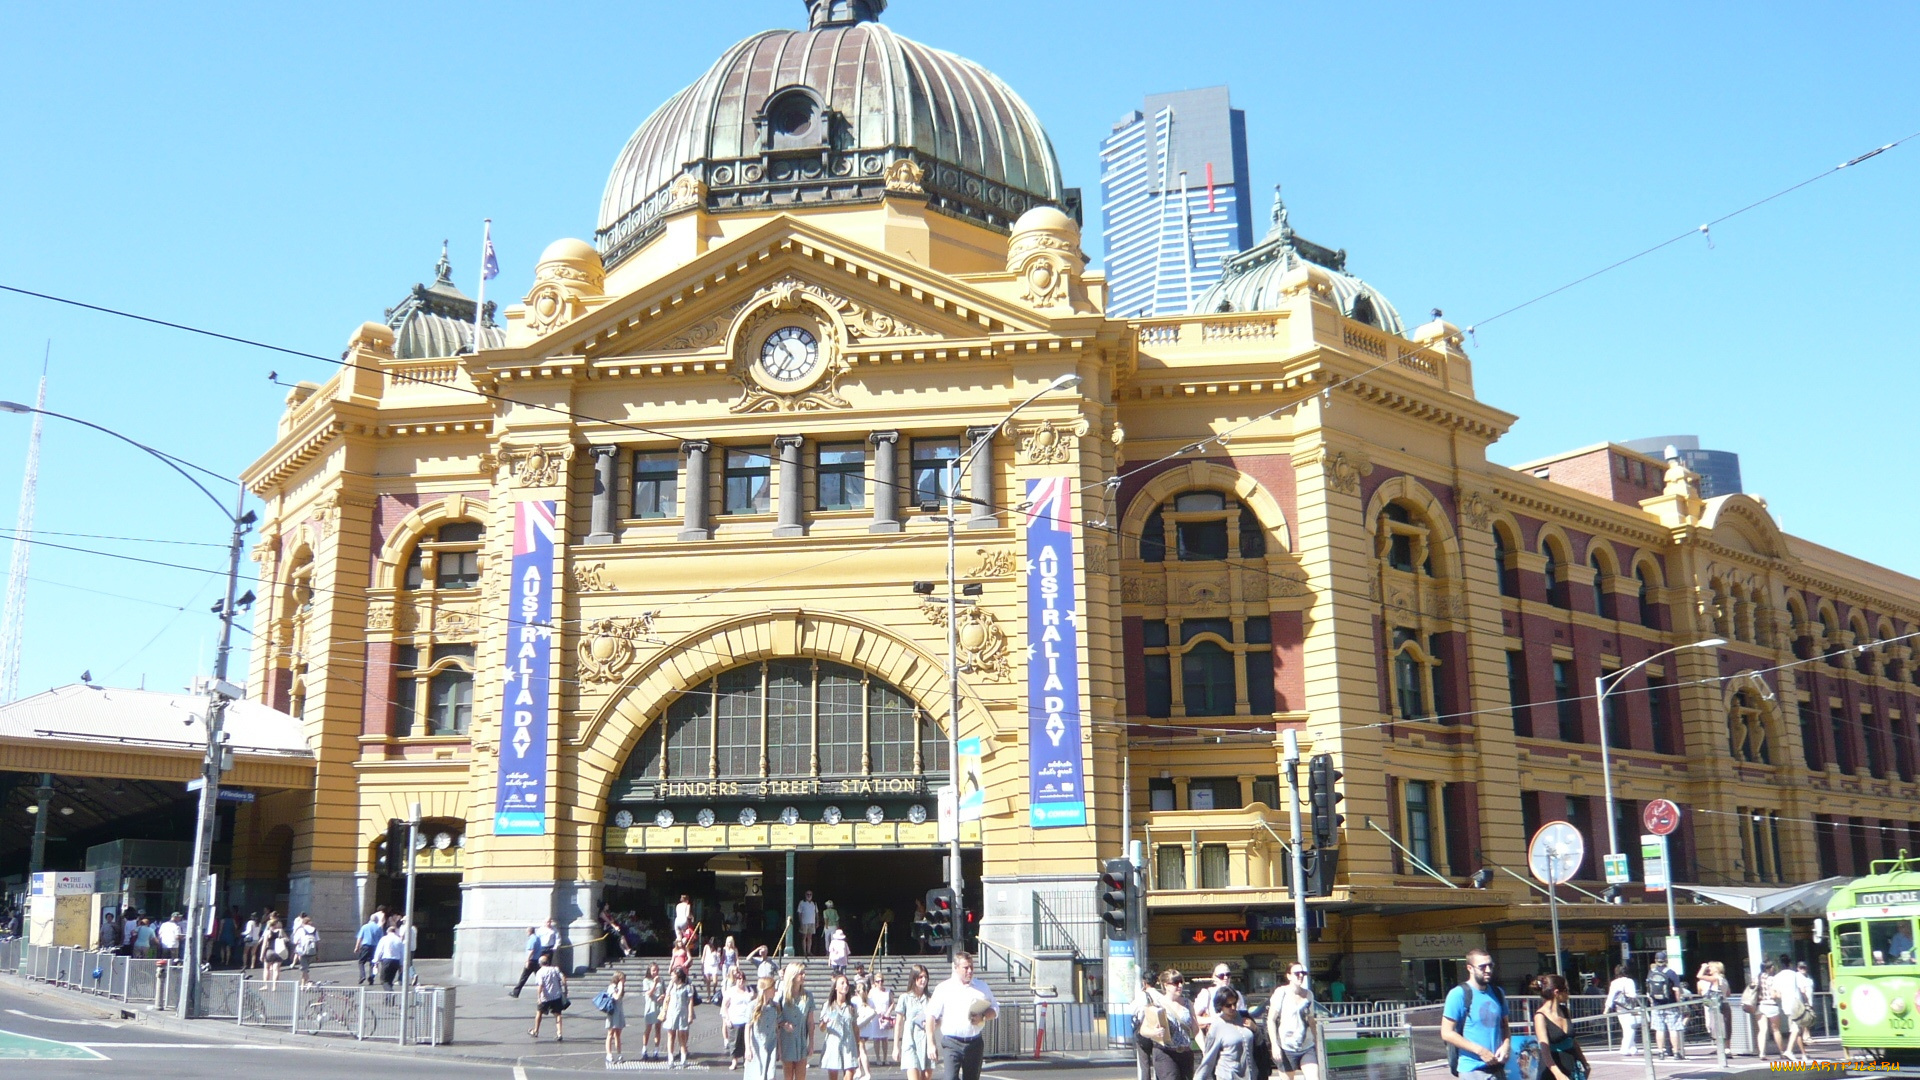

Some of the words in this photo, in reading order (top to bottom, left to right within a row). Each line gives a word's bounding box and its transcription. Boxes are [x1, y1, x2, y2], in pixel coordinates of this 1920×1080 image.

[1038, 545, 1064, 690] AUSTRALIA
[514, 566, 540, 705] AUSTRALIA
[512, 711, 532, 758] DAY
[1044, 696, 1065, 746] DAY
[660, 782, 738, 796] FLINDERS
[759, 780, 820, 795] STREET
[841, 778, 916, 793] STATION
[1863, 894, 1884, 904] CITY
[1887, 892, 1917, 904] CIRCLE
[1213, 930, 1250, 942] CITY
[1889, 1018, 1914, 1030] 1020
